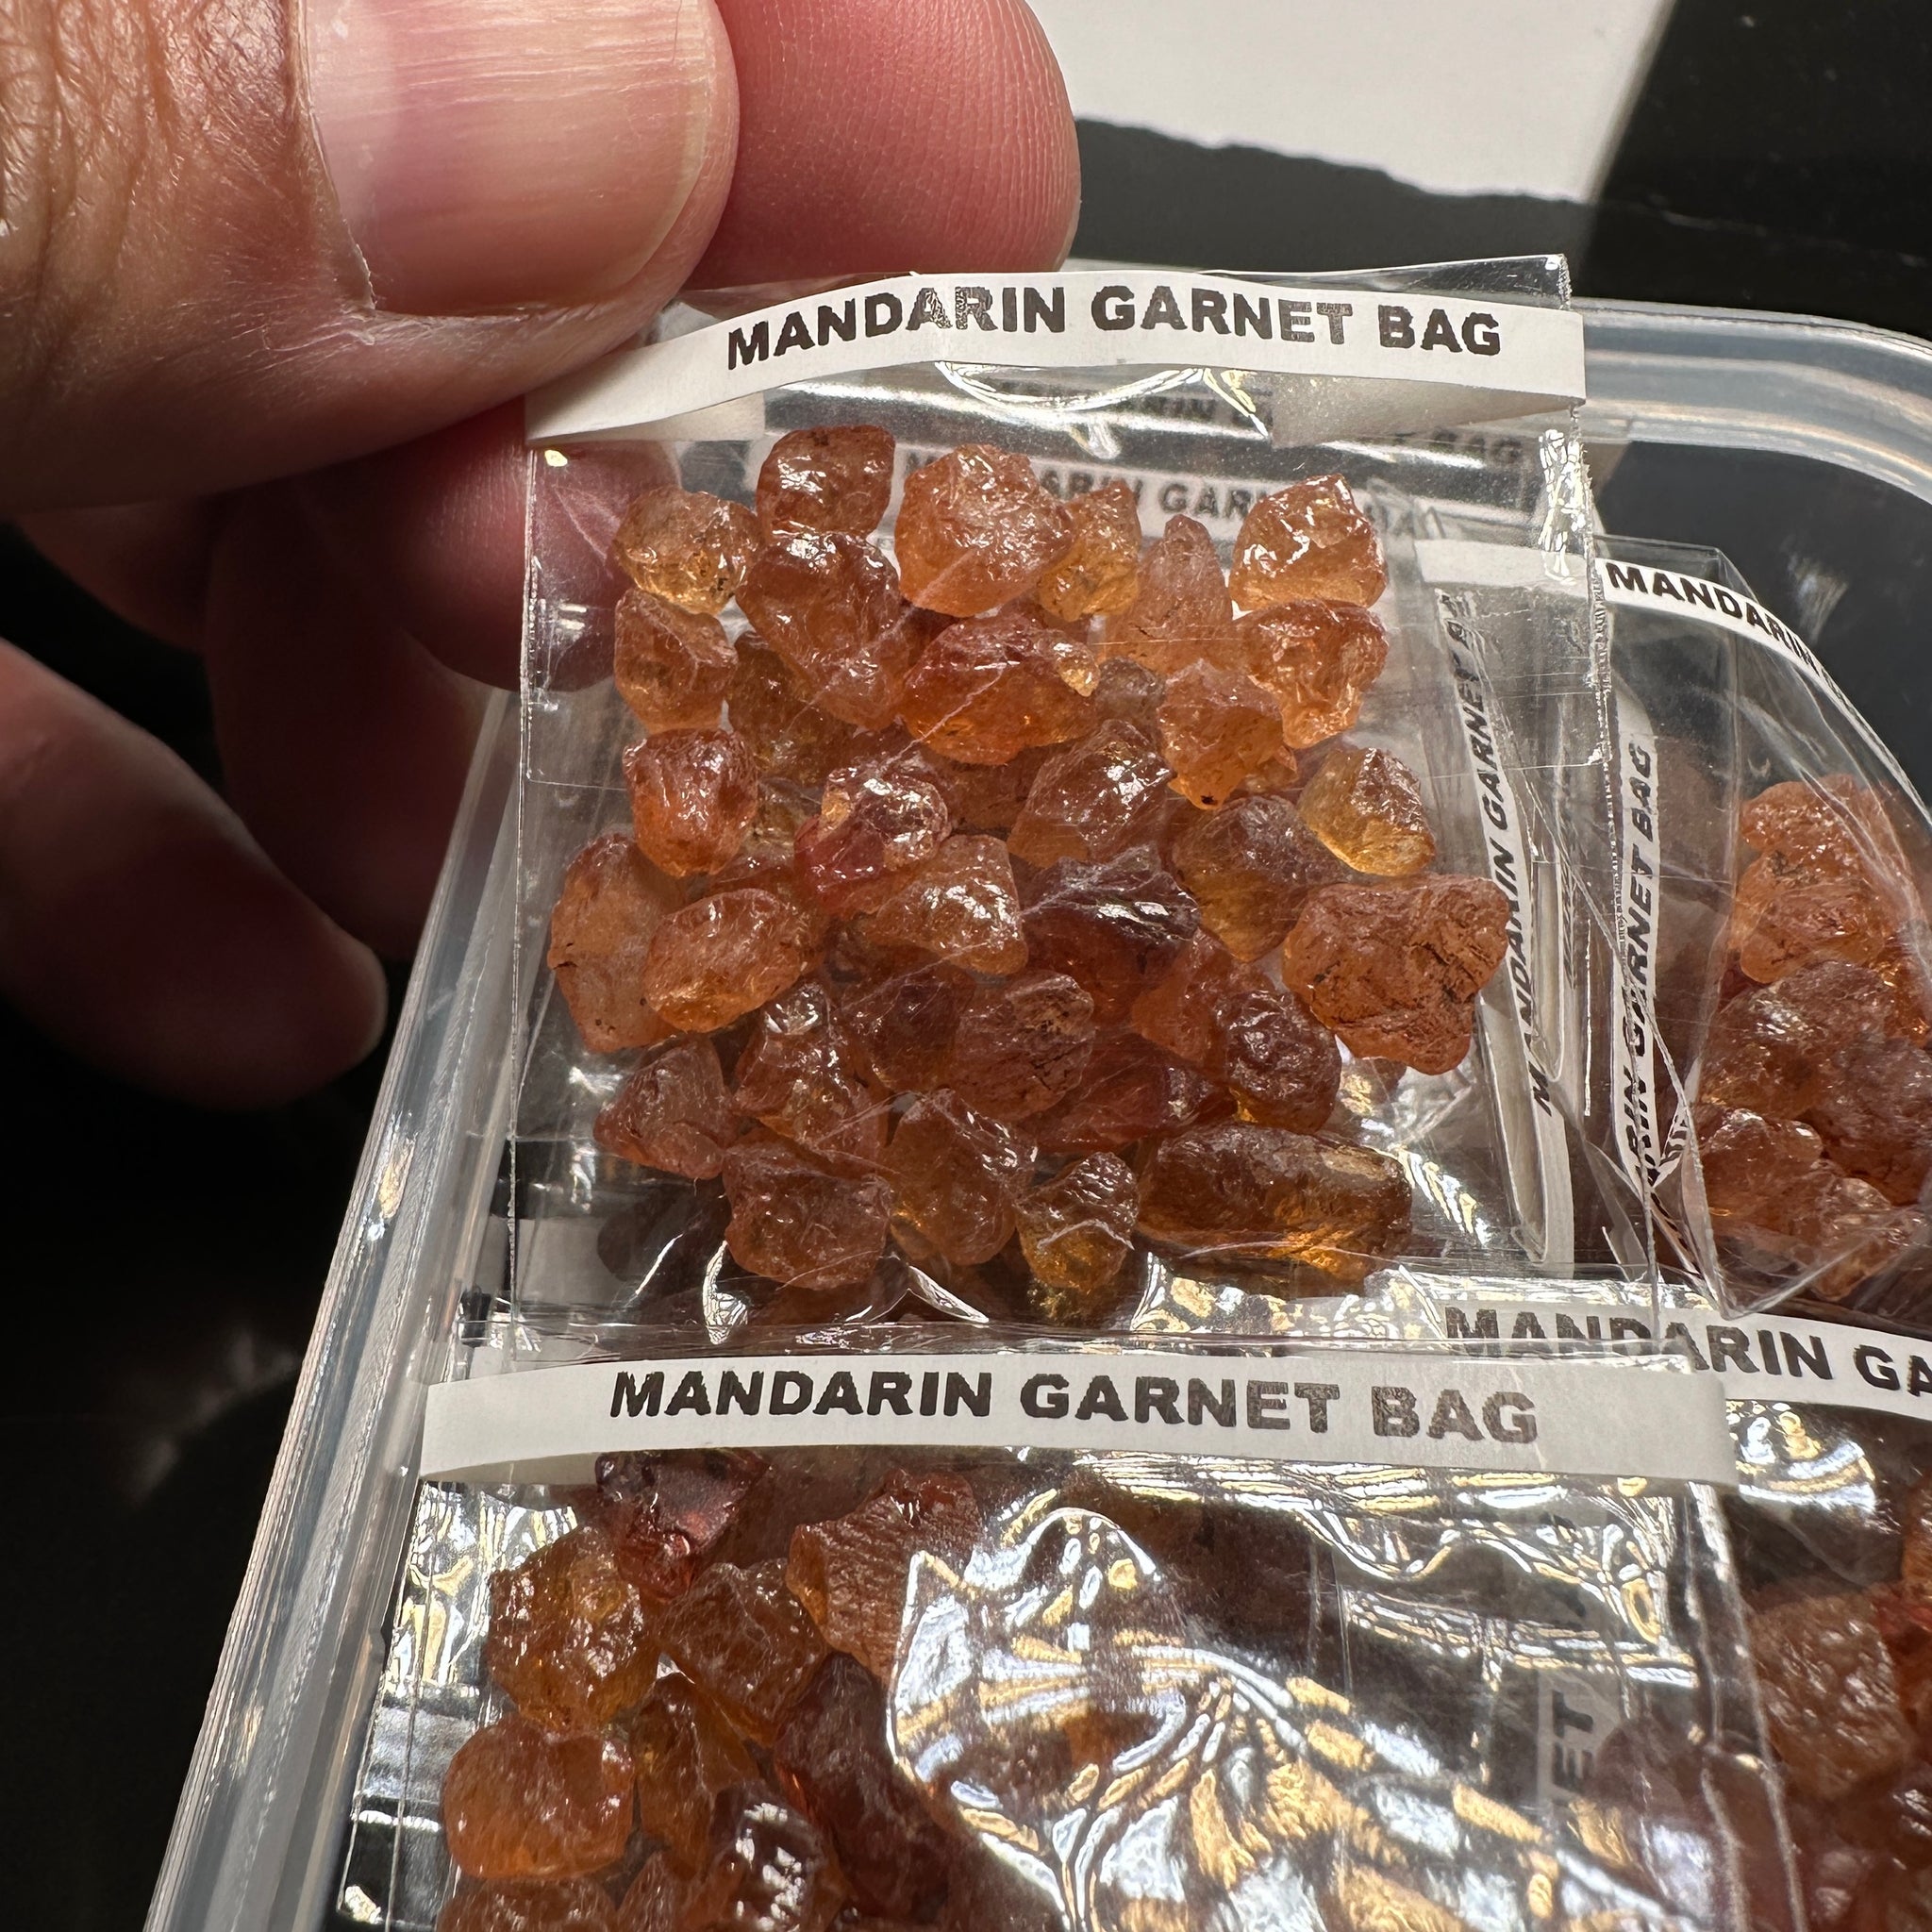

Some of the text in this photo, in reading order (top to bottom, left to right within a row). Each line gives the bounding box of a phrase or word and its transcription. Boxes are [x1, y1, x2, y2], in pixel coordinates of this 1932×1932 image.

[727, 285, 1502, 371] MANDARIN GARNET BAG
[1628, 741, 1654, 842] BAG
[1444, 1307, 1833, 1380] MANDARIN
[609, 1371, 1538, 1444] MANDARIN GARNET BAG
